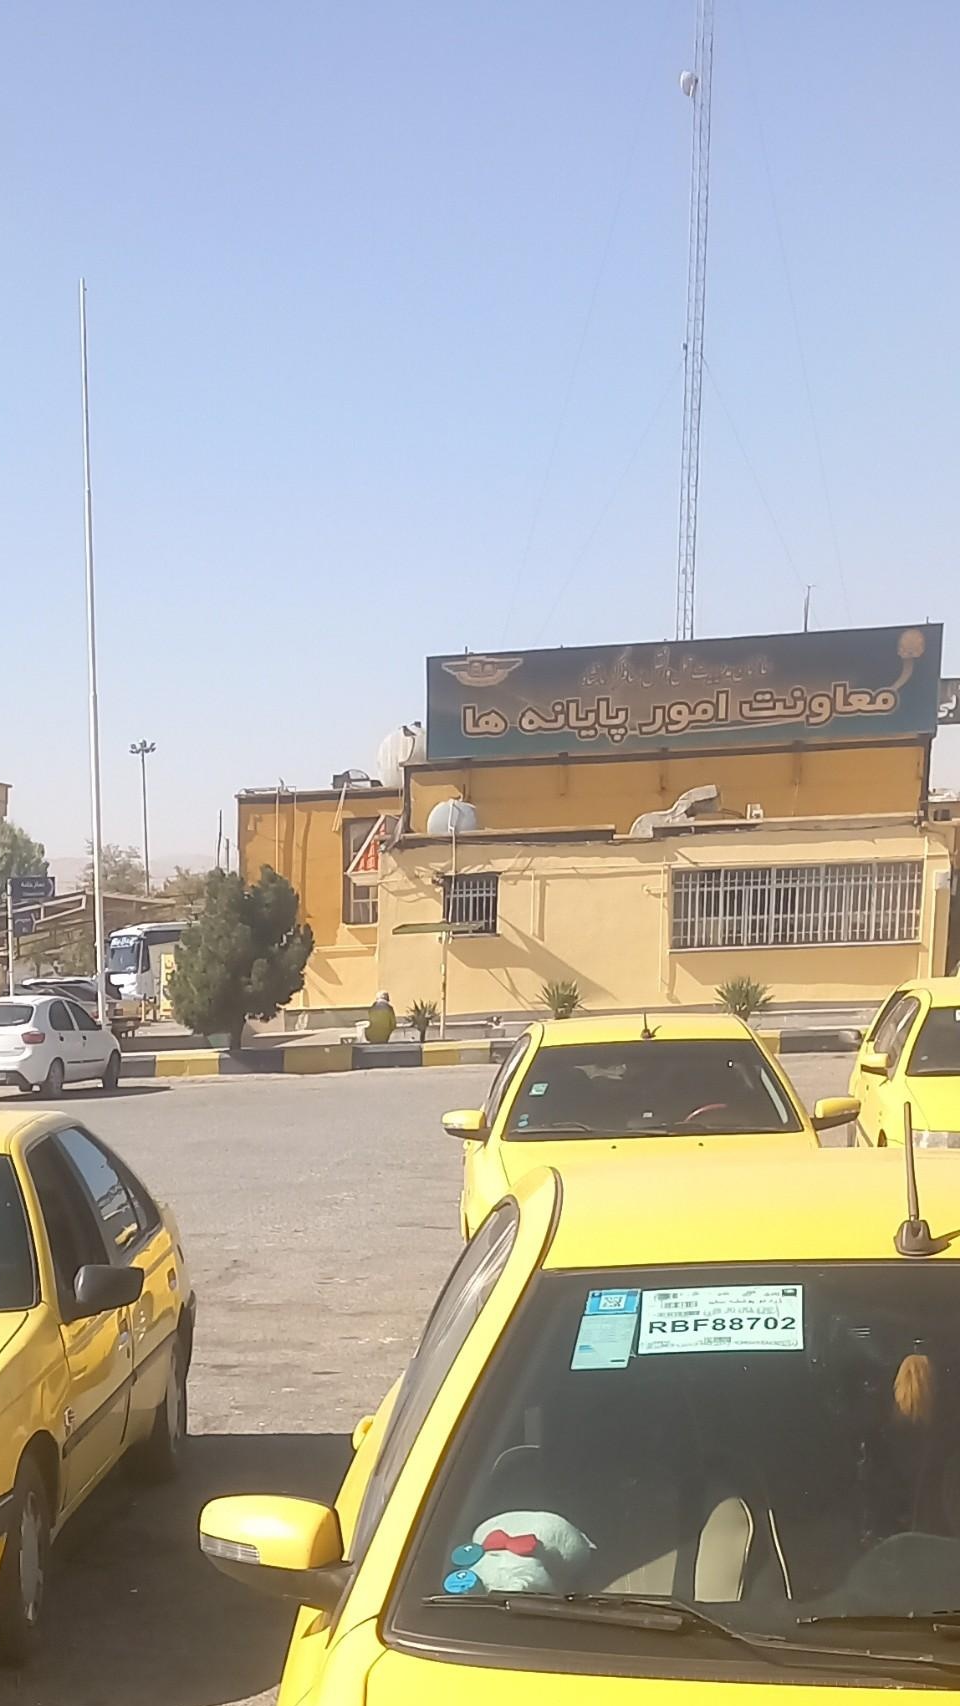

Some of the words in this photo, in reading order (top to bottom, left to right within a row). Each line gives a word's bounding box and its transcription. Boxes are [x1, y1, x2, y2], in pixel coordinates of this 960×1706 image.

[461, 703, 510, 737] ها
[518, 695, 630, 745] پایانه
[637, 687, 731, 737] امور
[738, 681, 898, 728] معاونت
[648, 1316, 796, 1334] RBF88702
